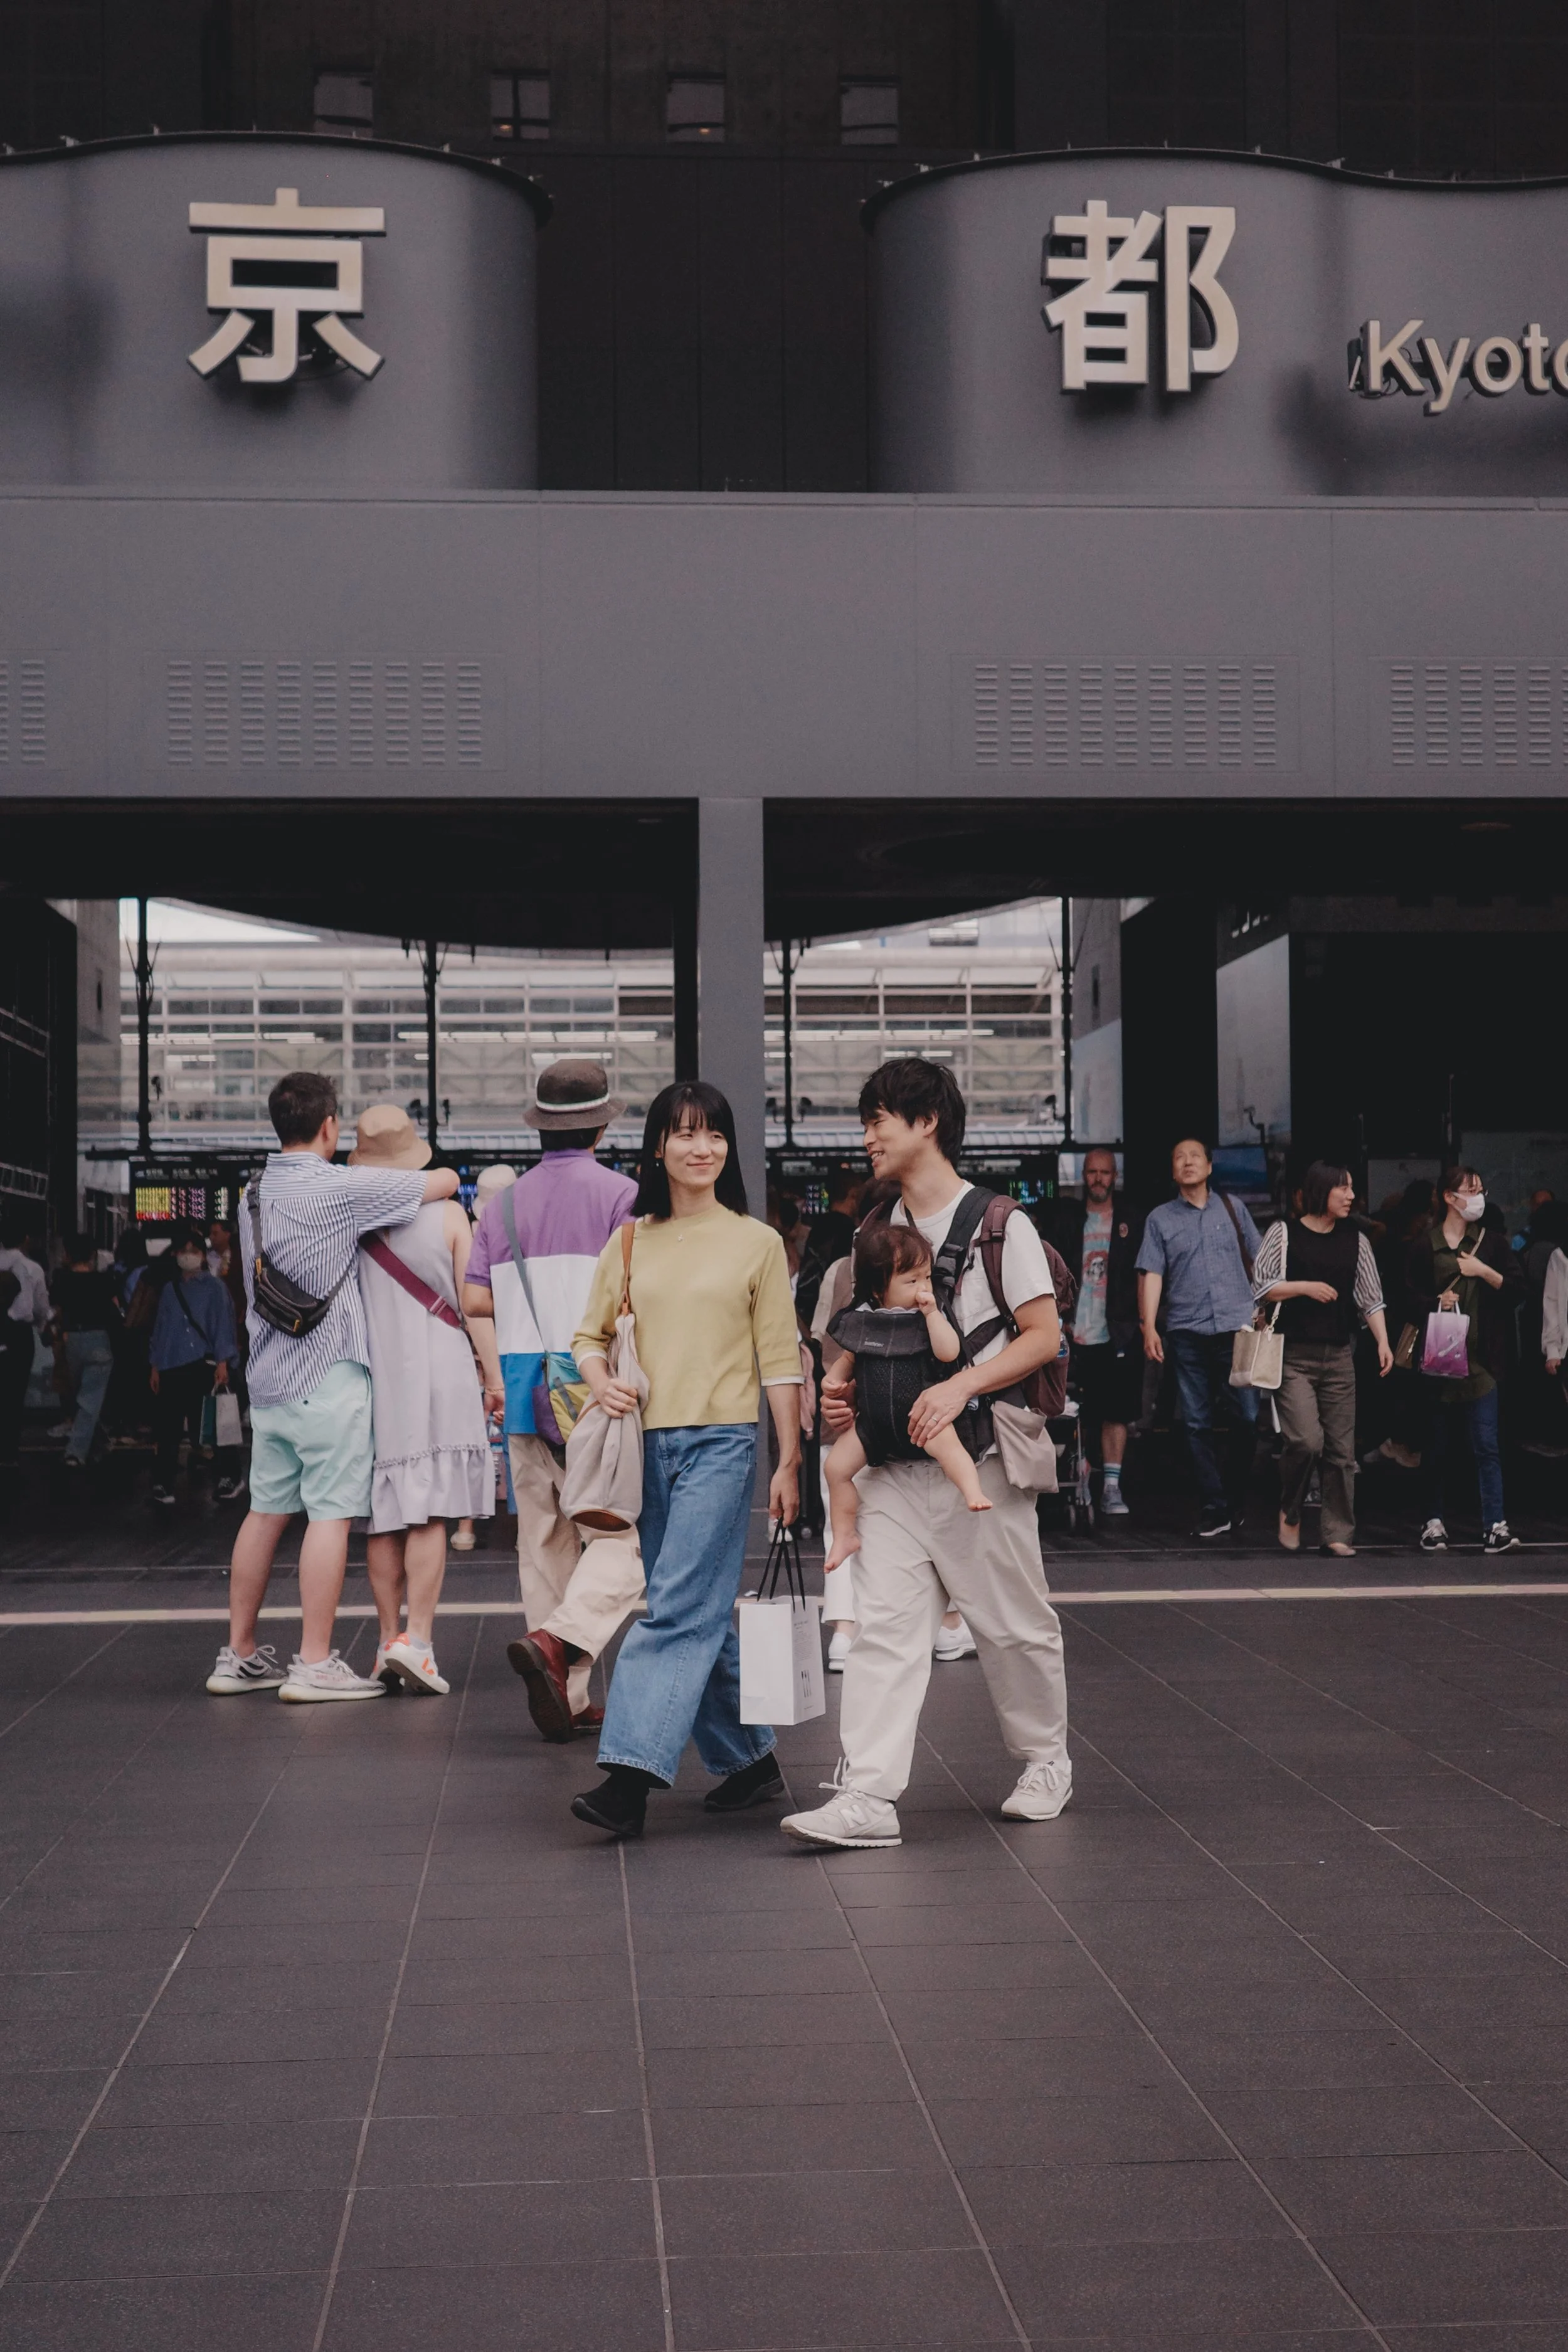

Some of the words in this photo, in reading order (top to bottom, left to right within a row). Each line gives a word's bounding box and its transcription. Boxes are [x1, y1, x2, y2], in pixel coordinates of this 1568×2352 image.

[188, 188, 384, 382] 京
[1045, 199, 1239, 391] 都
[1368, 319, 1568, 413] Kyot
[839, 1804, 867, 1828] N
